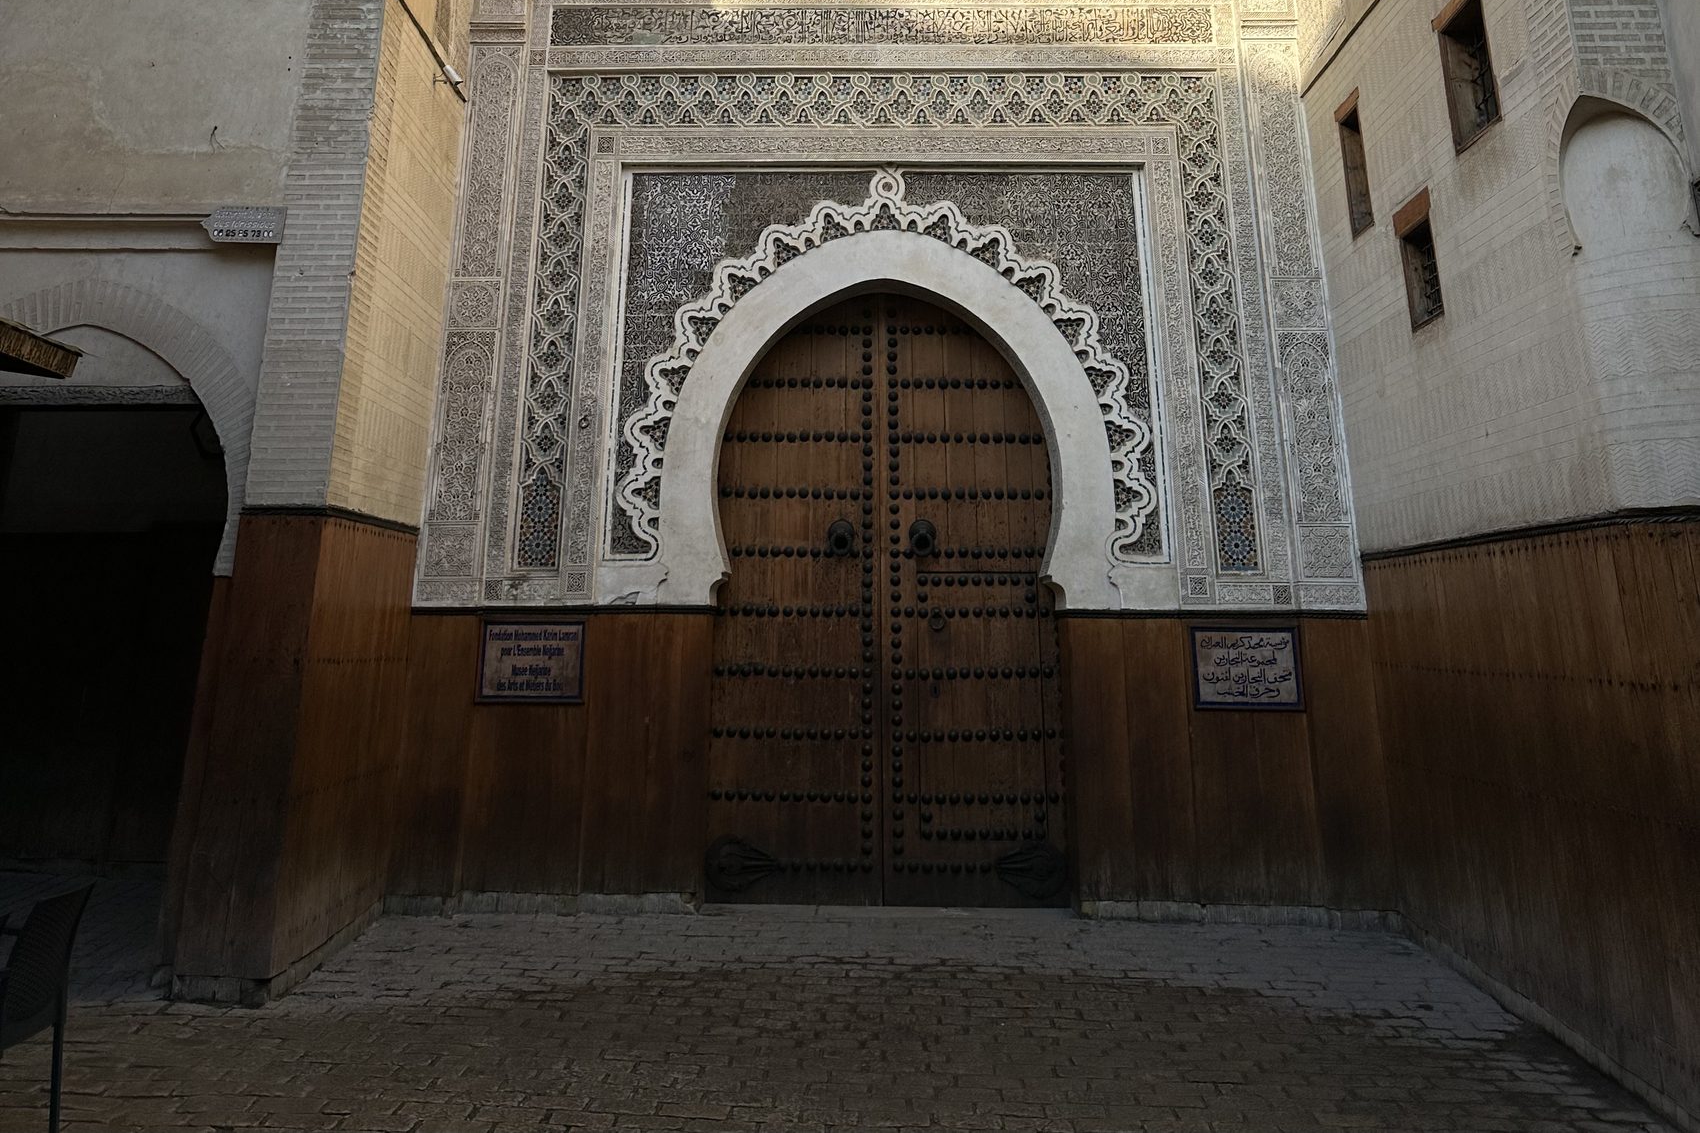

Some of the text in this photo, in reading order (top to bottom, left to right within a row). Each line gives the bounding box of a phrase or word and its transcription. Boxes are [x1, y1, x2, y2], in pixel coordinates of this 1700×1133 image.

[251, 229, 261, 238] 73
[489, 629, 513, 641] Fondation
[514, 629, 542, 641] Mohammed
[543, 629, 557, 641] Karim
[1227, 636, 1252, 650] كريم
[1245, 637, 1265, 650] محمد
[500, 647, 513, 659] pour
[1214, 650, 1243, 666] النجارين
[1232, 668, 1266, 684] النجارين
[1266, 669, 1292, 683] متحف
[496, 680, 506, 691] des
[507, 680, 518, 691] Arts
[519, 681, 525, 691] et
[1249, 685, 1280, 698] وحرف
